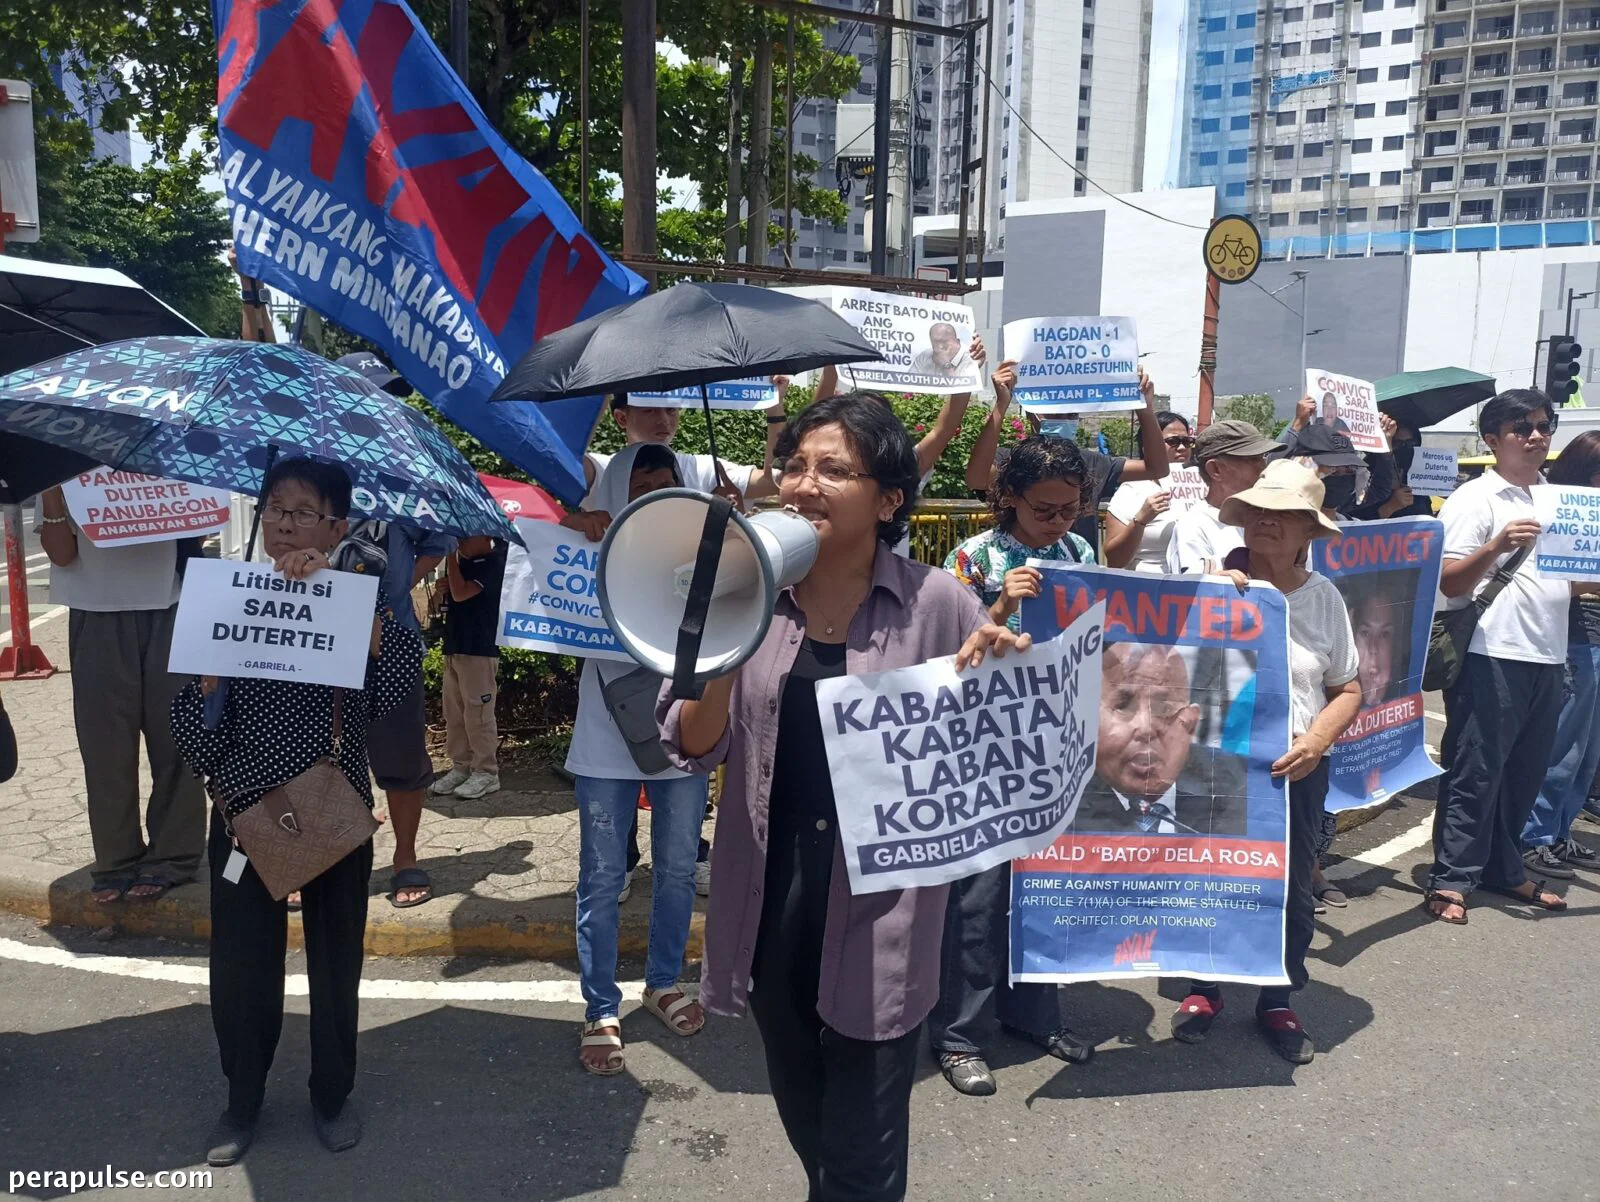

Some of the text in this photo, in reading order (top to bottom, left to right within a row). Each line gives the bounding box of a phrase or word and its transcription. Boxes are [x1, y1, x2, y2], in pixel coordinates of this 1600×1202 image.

[220, 149, 509, 380] ALYANSANG MAKABAYA
[840, 297, 970, 325] ARREST BATO NOW!
[330, 256, 474, 390] MINDANAO
[863, 315, 893, 329] ANG
[1033, 326, 1101, 342] HAGDAN
[1045, 345, 1087, 361] BATO
[844, 369, 971, 386] GABRIELA YOUTH DAVAO
[1019, 361, 1133, 377] #BATOARESTUHIN
[714, 388, 731, 398] PL
[741, 389, 771, 399] SMR
[1014, 390, 1083, 401] KABATAAN
[1087, 388, 1103, 398] PL
[1112, 386, 1139, 397] SMR
[1317, 376, 1371, 401] CONVICT
[1345, 396, 1369, 410] SARA
[1338, 407, 1375, 424] DUTERTE
[1351, 421, 1376, 435] NOW!
[1422, 451, 1445, 461] Marcos
[1424, 462, 1449, 471] Duterte
[104, 482, 190, 503] DUTERTE
[86, 496, 219, 523] PANUBAGON
[1556, 507, 1585, 522] SEA,
[98, 513, 219, 536] ANAKBAYAN SMR
[1546, 522, 1600, 538] ANG SU
[1325, 530, 1434, 570] CONVICT
[1573, 539, 1591, 552] SA
[1539, 558, 1598, 570] KABATAAN
[231, 571, 333, 599] Litisin si
[243, 598, 313, 622] SARA
[528, 592, 601, 619] #CONVIC
[1053, 584, 1265, 642] WANTED
[211, 622, 335, 652] DUTERTE!
[509, 617, 616, 646] KABATAAN
[244, 660, 296, 673] GABRIELA
[832, 623, 1101, 735] KABABAIHANG
[1365, 700, 1416, 732] DUTERTE
[902, 735, 1047, 798] LABAN
[873, 720, 1086, 836] KORAPSYON
[873, 823, 989, 868] GABRIELA
[990, 806, 1062, 840] YOUTH
[1164, 847, 1214, 864] DELA
[1219, 848, 1280, 868] ROSA
[1023, 879, 1261, 895] CRIME AGAINST HUMANITY OF MURDER
[1018, 895, 1261, 912] (ARTICLE 7(1)(A) OF THE ROME STATUTE)
[1053, 915, 1217, 928] ARCHITECT: OPLAN TOKHANG
